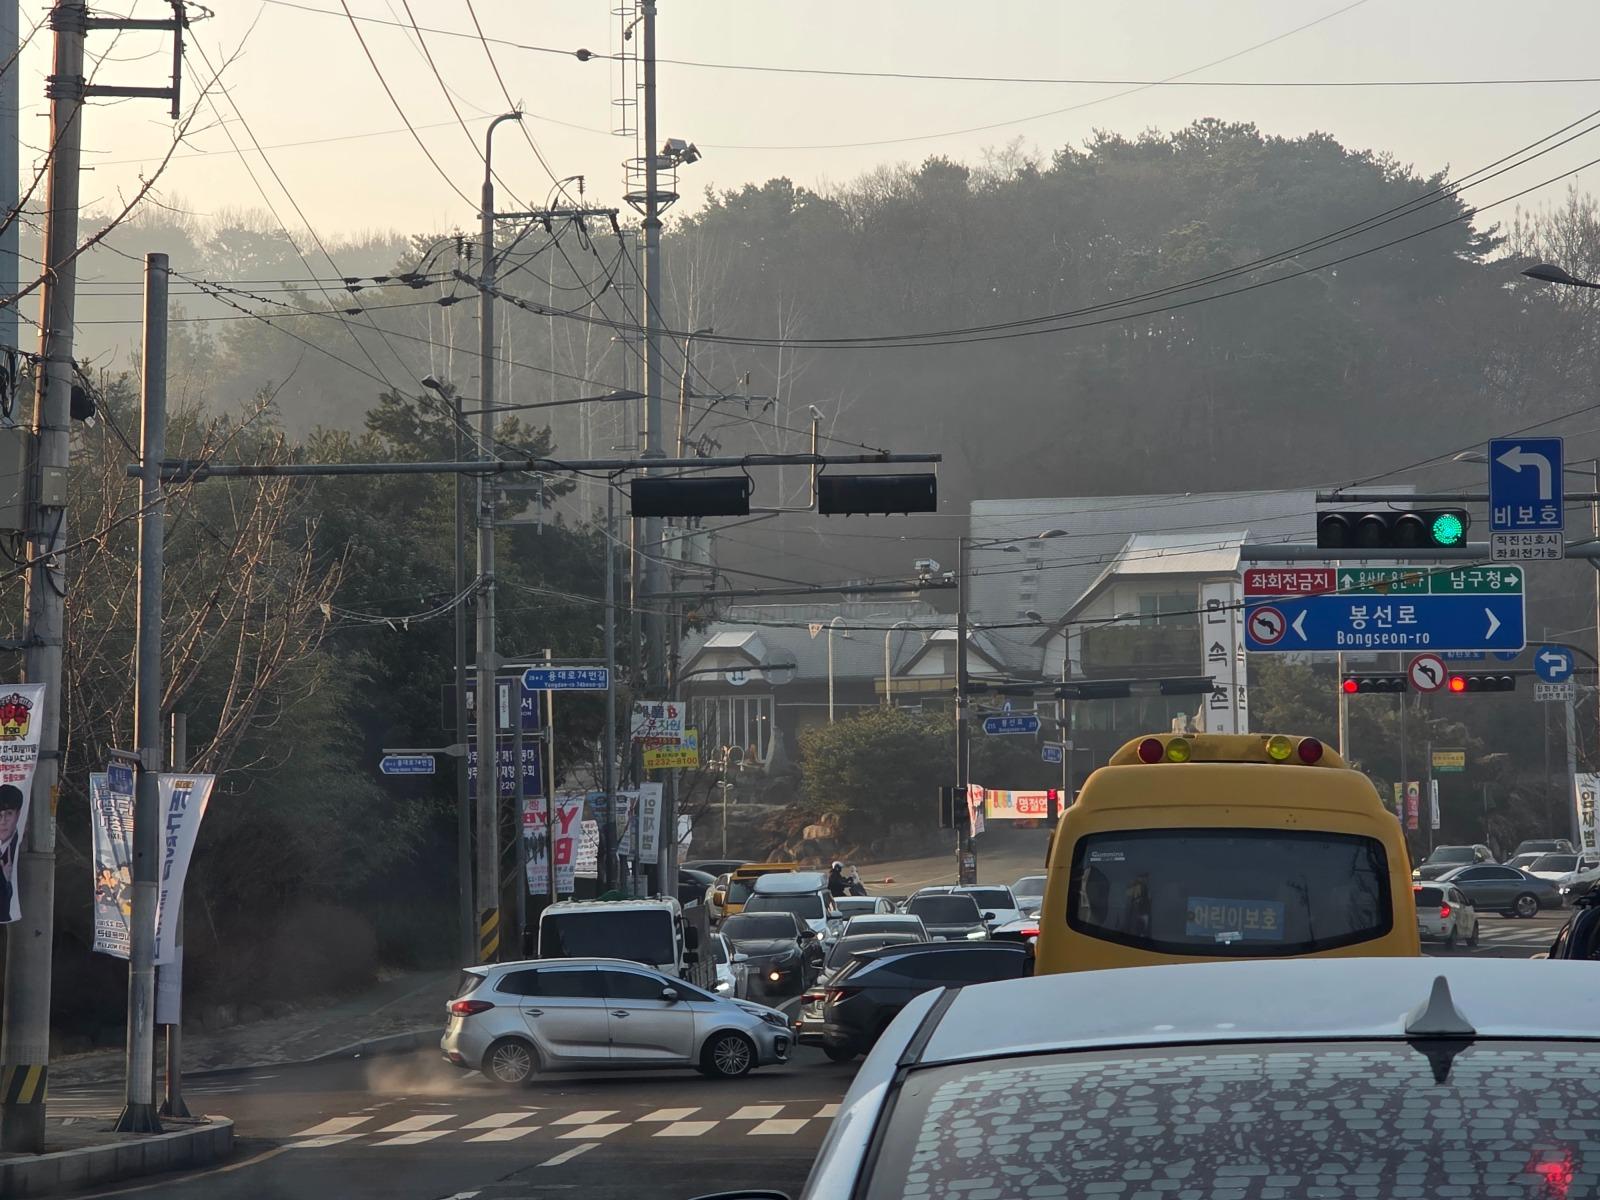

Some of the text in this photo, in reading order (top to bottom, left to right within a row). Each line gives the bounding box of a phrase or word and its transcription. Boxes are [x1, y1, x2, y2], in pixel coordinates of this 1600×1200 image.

[1494, 506, 1559, 527] 비보호
[1496, 535, 1558, 546] 직진신호시
[1496, 547, 1558, 558] 좌회전가능
[1251, 573, 1328, 590] 좌회전금지
[1451, 572, 1501, 591] 남구청
[1349, 606, 1418, 629] 봉선로
[1337, 630, 1430, 648] Bongseon-ro
[1193, 904, 1278, 931] 어린이보호
